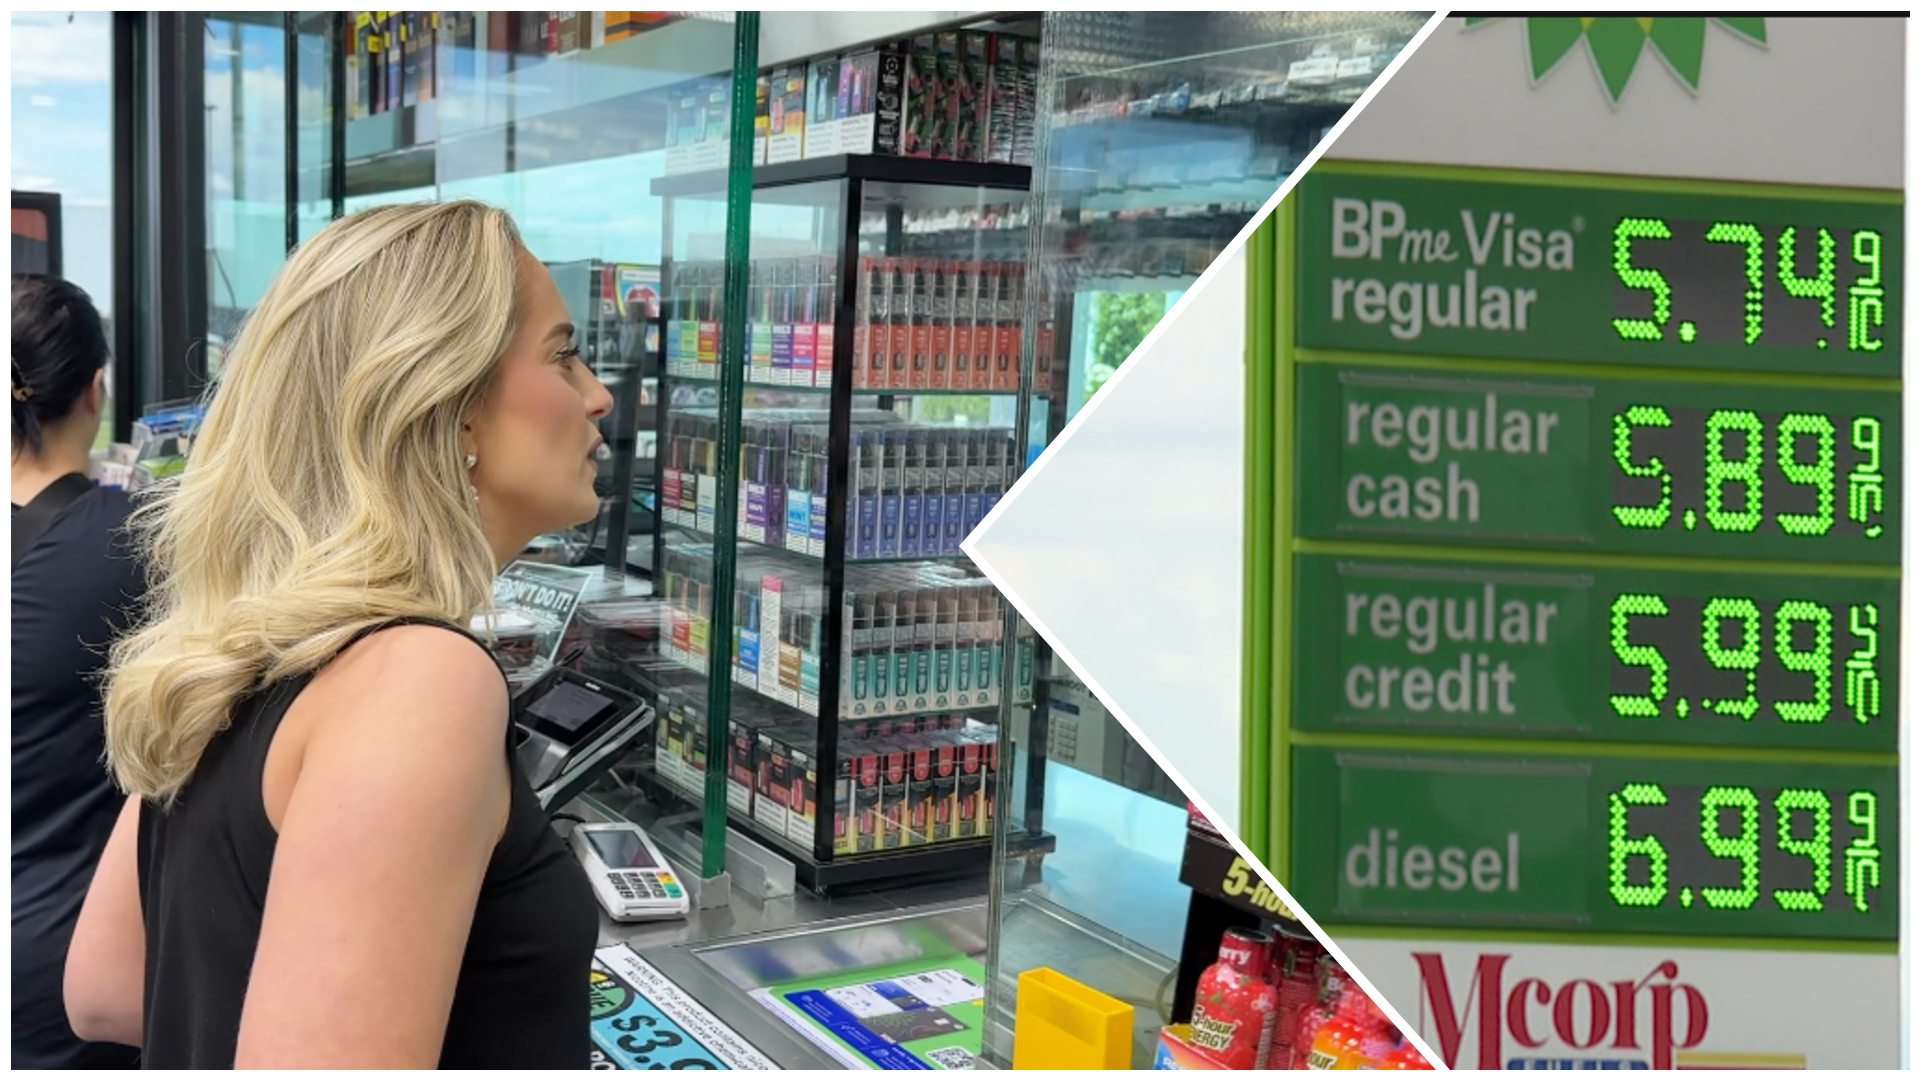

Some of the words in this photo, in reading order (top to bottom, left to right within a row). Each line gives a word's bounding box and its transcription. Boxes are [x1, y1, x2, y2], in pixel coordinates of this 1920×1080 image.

[1331, 267, 1538, 340] regular
[1347, 393, 1559, 464] regular
[1346, 461, 1480, 523] cash
[1612, 405, 1835, 535] 5.89
[533, 586, 557, 607] DO
[552, 591, 574, 612] IT!
[1346, 583, 1558, 654] regular
[1345, 653, 1517, 714] credit
[1610, 594, 1833, 722] 5.99
[1345, 829, 1520, 892] diesel
[1609, 783, 1831, 911] 6.99
[1411, 952, 1710, 1070] Mcorp
